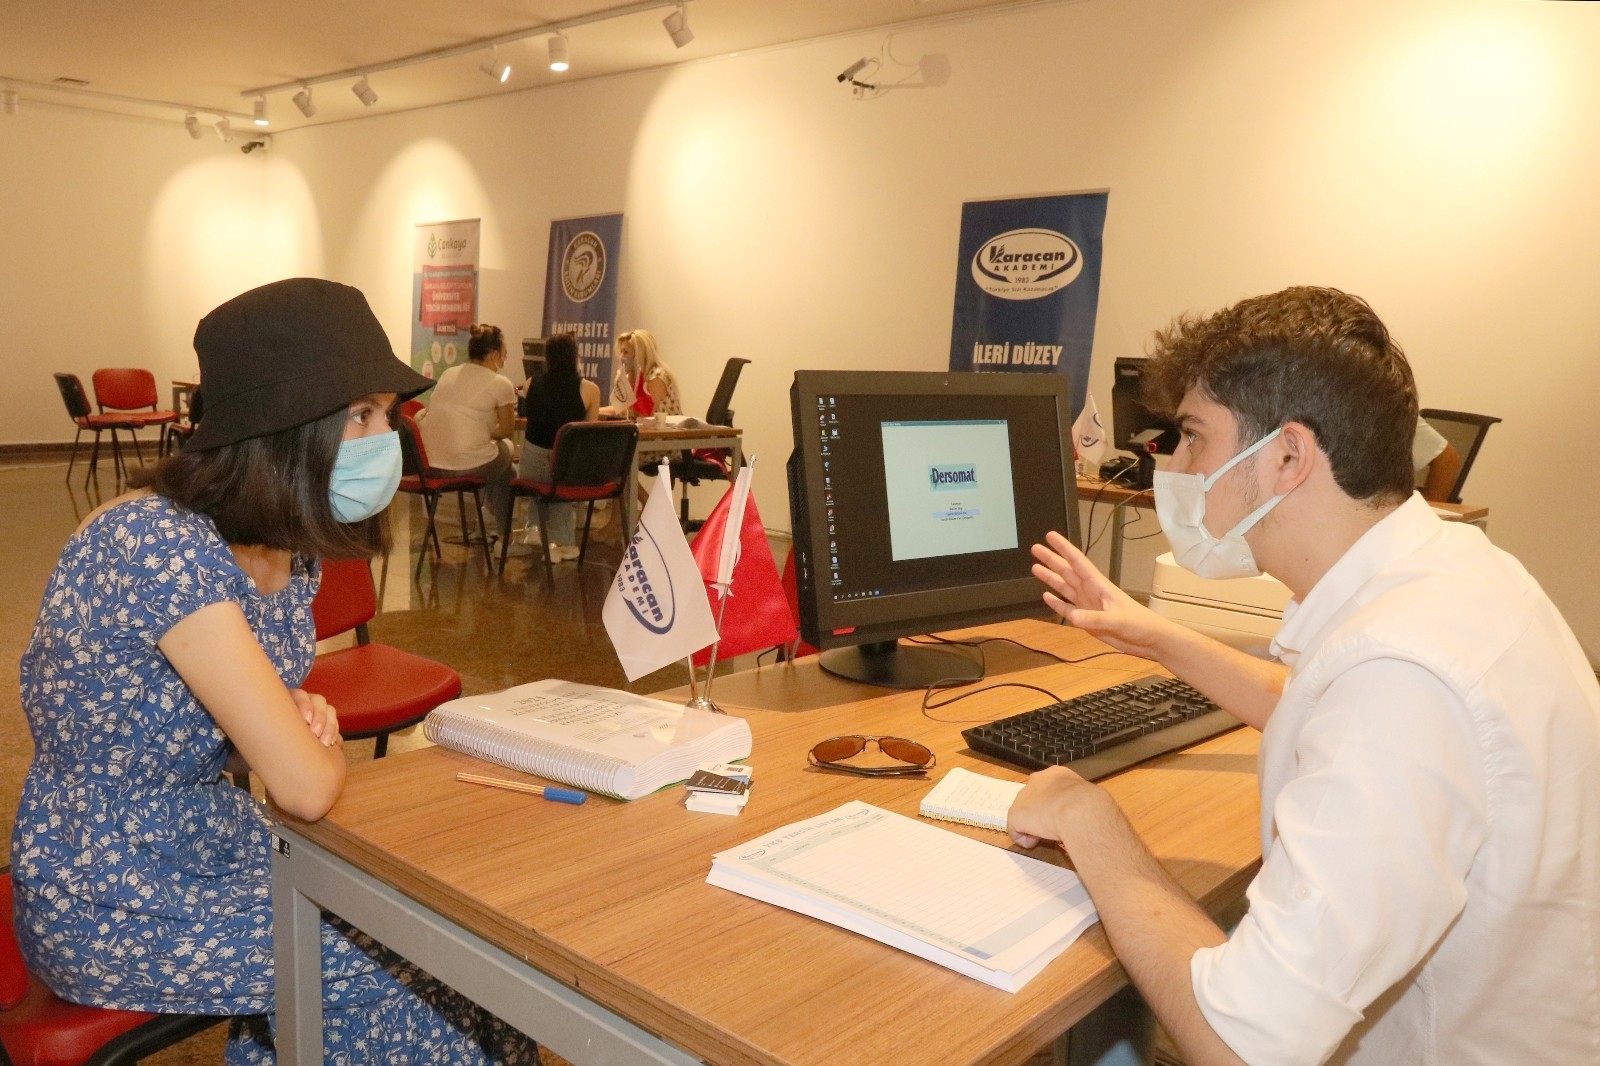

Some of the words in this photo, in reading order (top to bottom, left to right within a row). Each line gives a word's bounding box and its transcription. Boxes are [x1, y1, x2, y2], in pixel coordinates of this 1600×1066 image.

[989, 244, 1066, 263] Karacan
[1015, 276, 1030, 284] 1983
[551, 320, 609, 338] ÜNİVERSİTE
[973, 341, 1009, 364] İLERİ
[1012, 341, 1064, 366] DÜZEY
[930, 466, 976, 486] Dersomat
[616, 573, 626, 592] 1983
[628, 536, 664, 622] aracan
[763, 838, 783, 849] YKS
